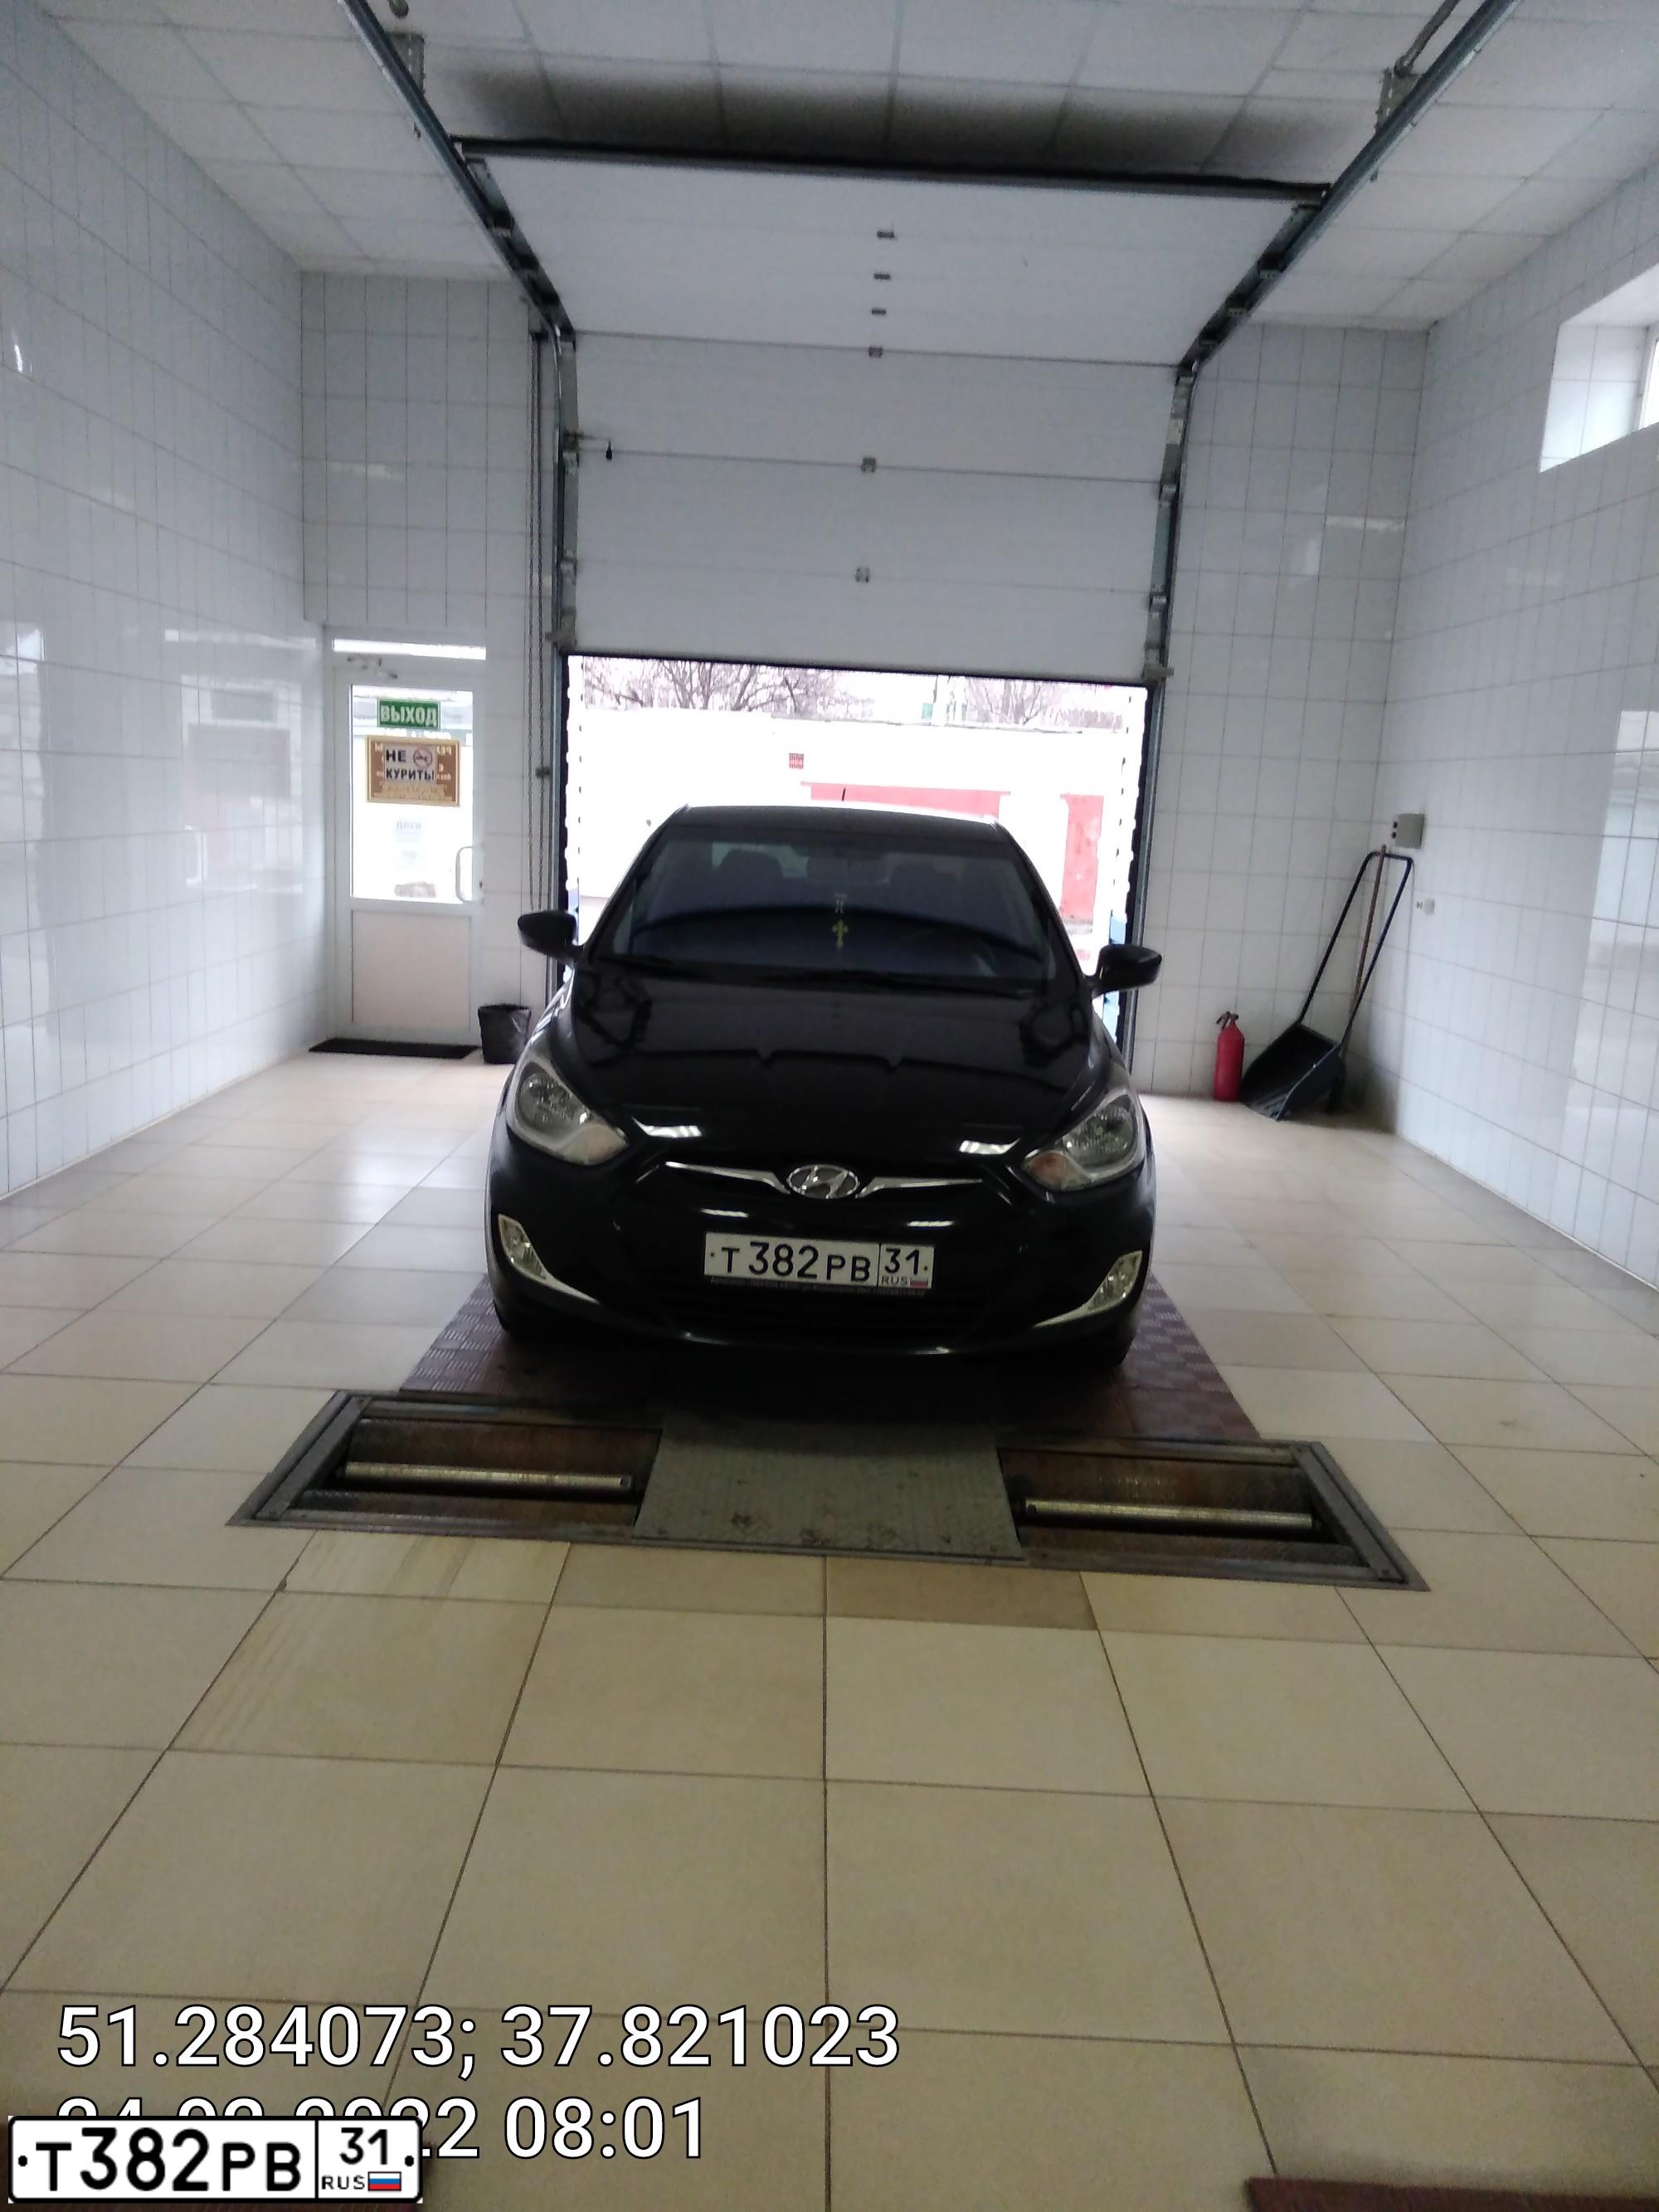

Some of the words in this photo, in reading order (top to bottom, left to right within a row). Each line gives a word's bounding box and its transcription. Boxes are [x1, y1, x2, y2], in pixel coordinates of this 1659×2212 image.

[381, 704, 437, 727] ВЫХОД
[385, 749, 406, 763] НЕ
[721, 1241, 871, 1283] Т382РВ
[884, 1248, 920, 1275] 31
[881, 1275, 907, 1286] RUS
